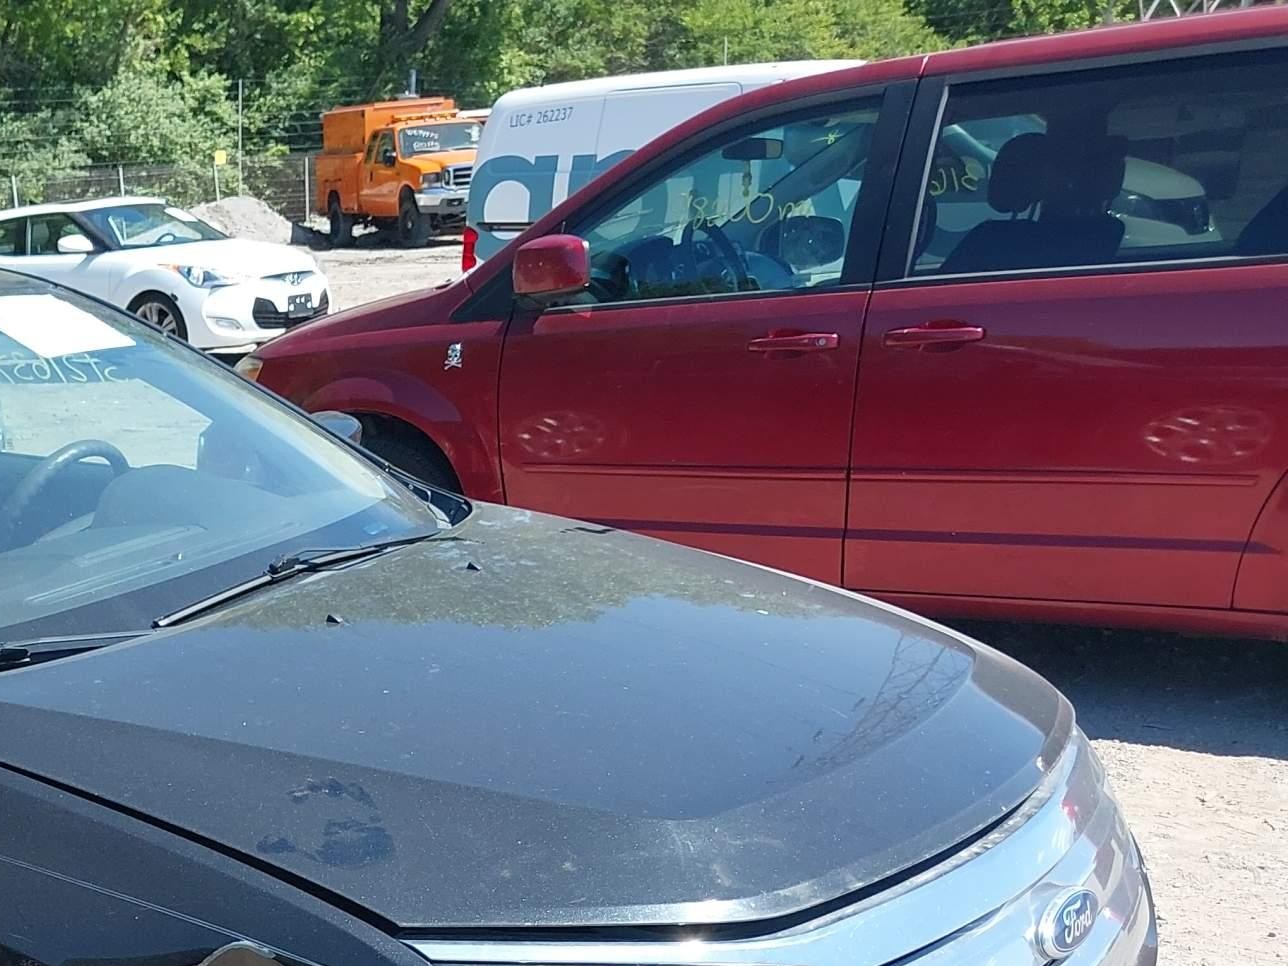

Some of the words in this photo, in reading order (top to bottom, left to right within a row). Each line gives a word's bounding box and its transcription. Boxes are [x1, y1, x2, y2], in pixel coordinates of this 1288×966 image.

[509, 112, 533, 129] LIC#
[536, 106, 574, 126] 262237
[1063, 900, 1093, 944] Ford
